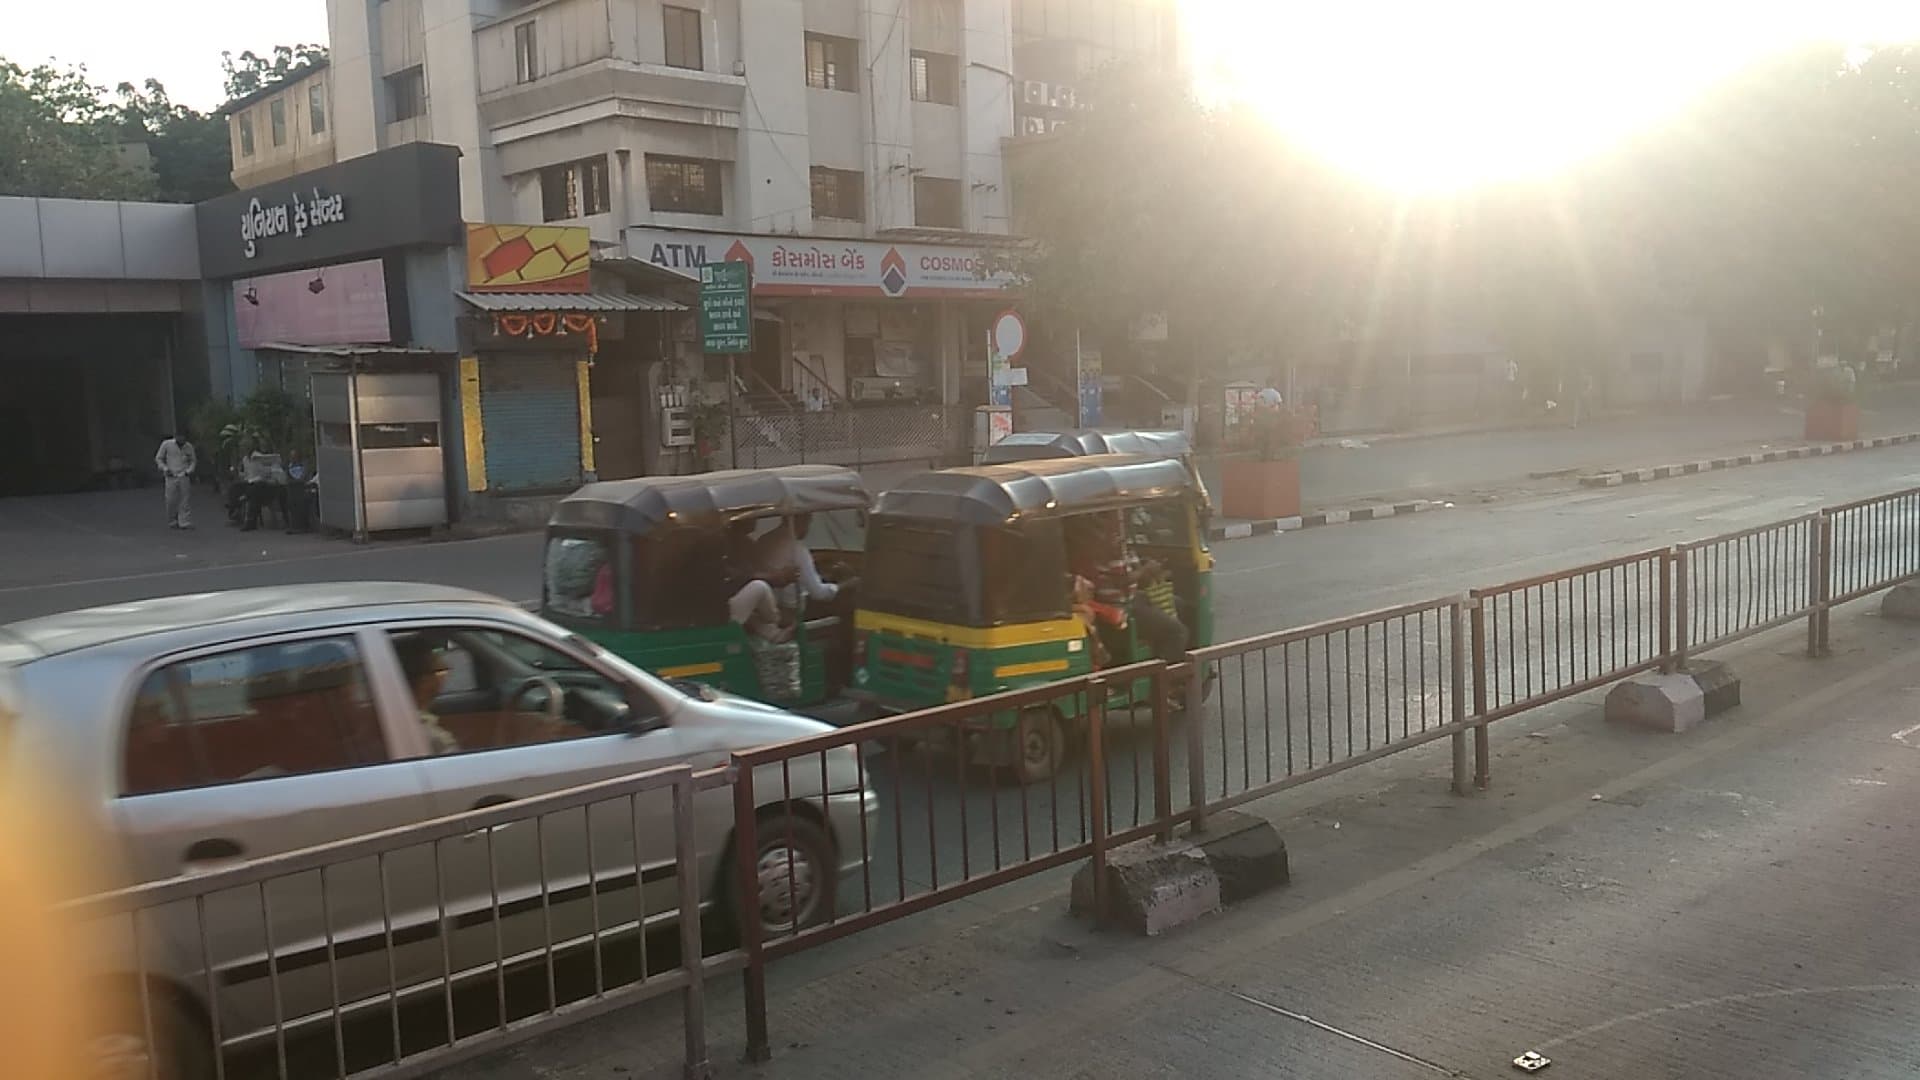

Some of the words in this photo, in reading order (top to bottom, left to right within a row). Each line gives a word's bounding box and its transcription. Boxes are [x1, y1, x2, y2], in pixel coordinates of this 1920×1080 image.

[241, 197, 289, 258] યુનિયન
[650, 243, 706, 268] ATM
[772, 245, 836, 269] કોસમોસ
